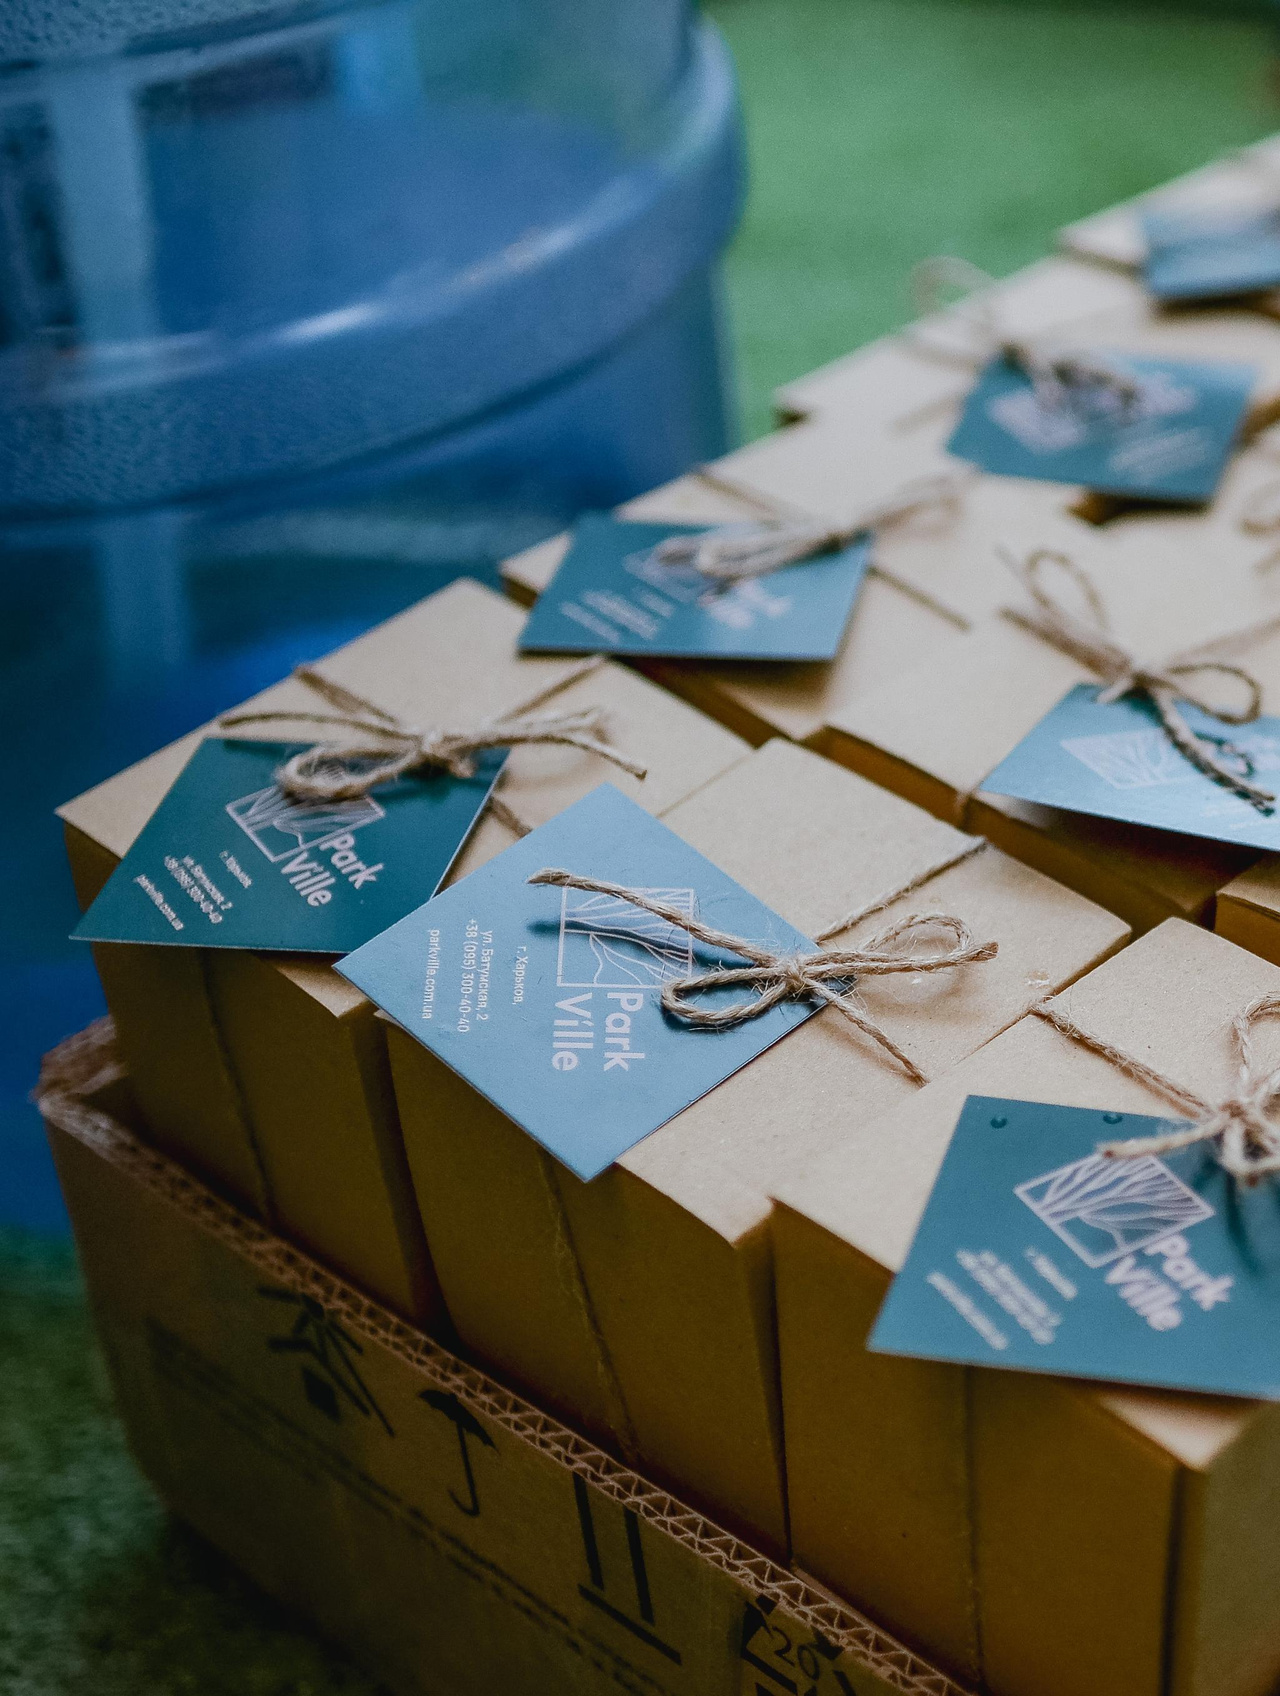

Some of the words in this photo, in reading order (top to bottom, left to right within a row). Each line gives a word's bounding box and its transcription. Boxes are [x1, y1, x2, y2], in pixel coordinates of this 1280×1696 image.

[281, 851, 335, 907] Ville
[319, 833, 384, 889] Park
[461, 940, 479, 970] (095)
[465, 919, 478, 938] +38
[480, 930, 493, 947] ул.
[421, 929, 440, 1019] parkville.com.ua
[457, 972, 475, 1033] 300-40-40
[476, 948, 494, 1011] Батумская,
[512, 956, 528, 1005] Харьков,
[552, 992, 594, 1071] Ville
[603, 992, 645, 1071] Park
[1144, 1235, 1234, 1311] Park
